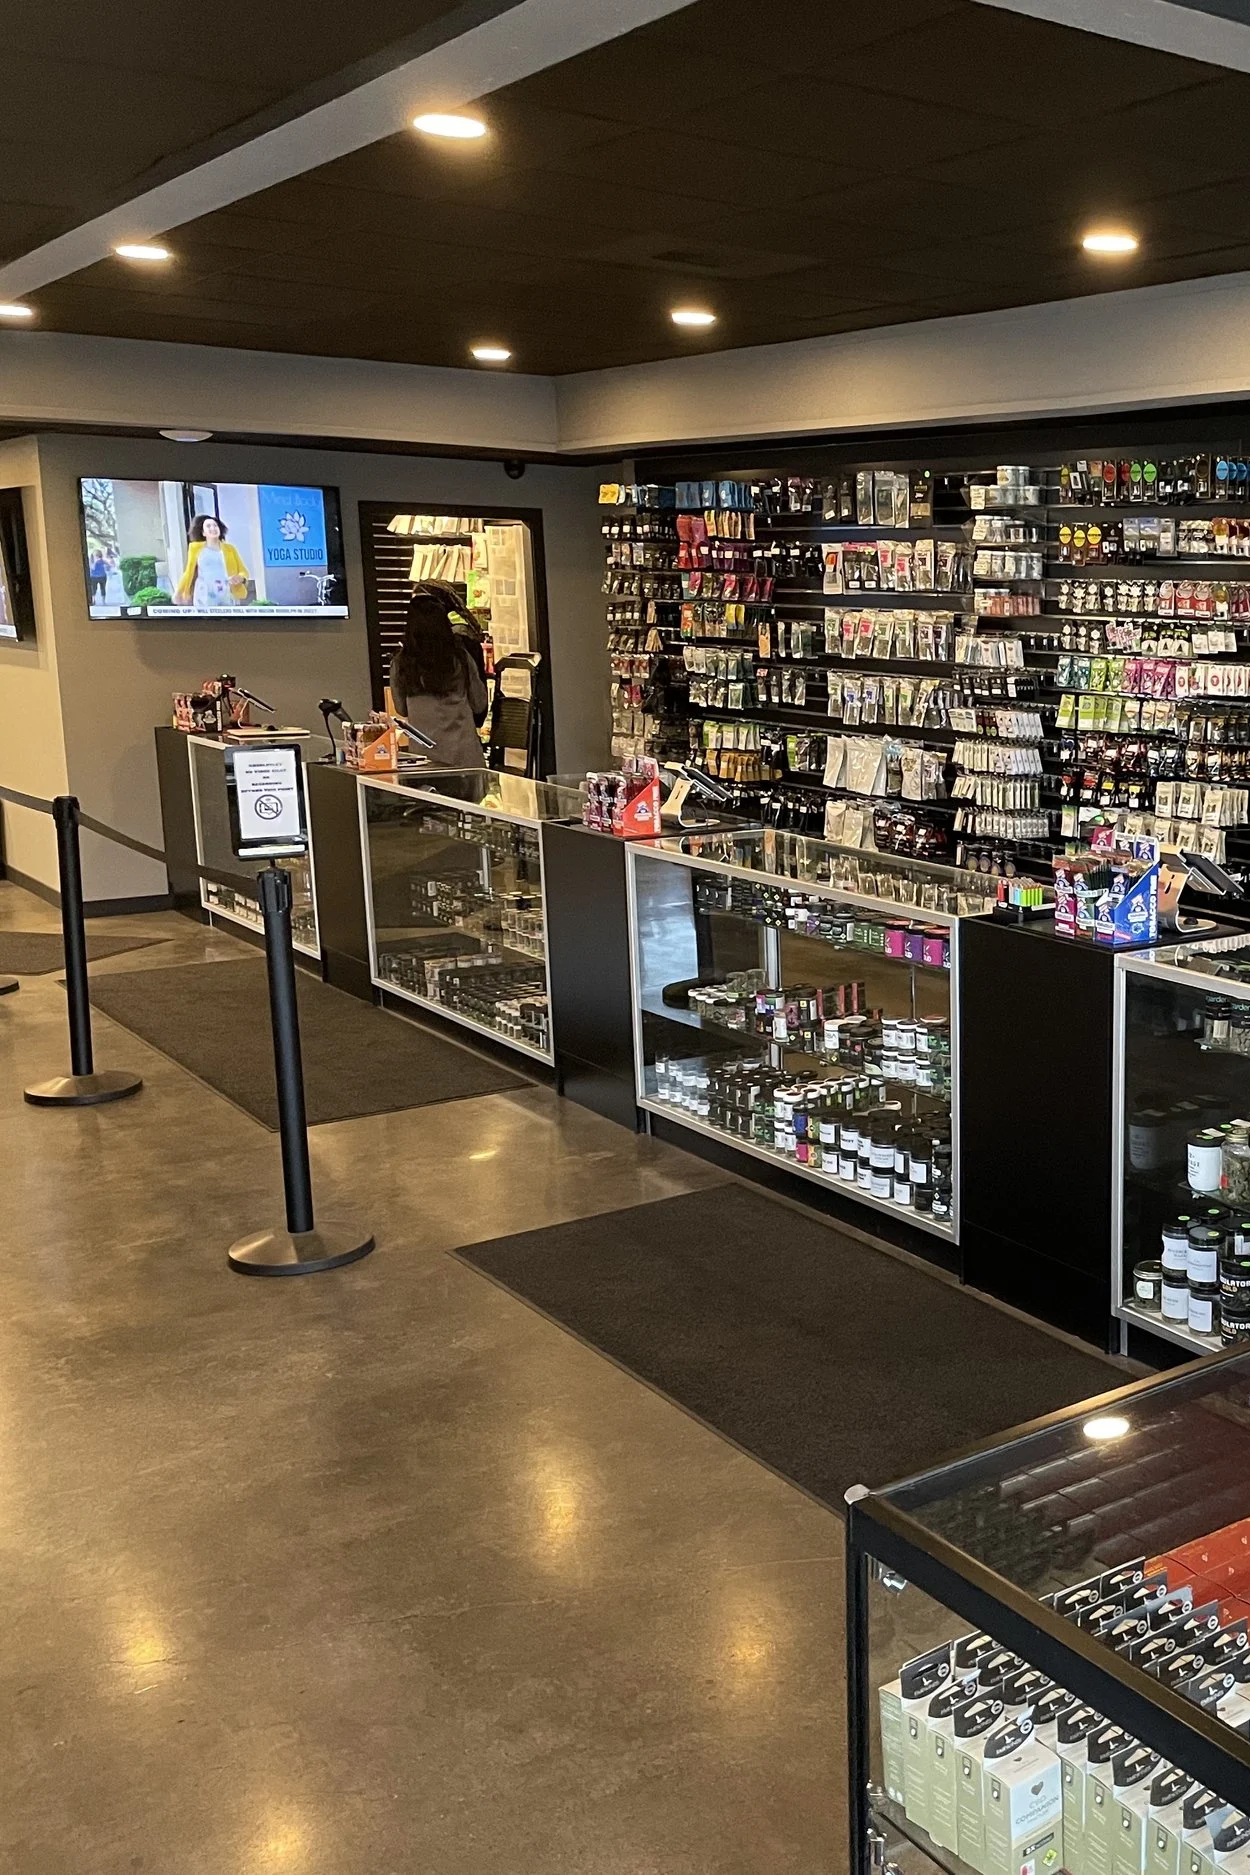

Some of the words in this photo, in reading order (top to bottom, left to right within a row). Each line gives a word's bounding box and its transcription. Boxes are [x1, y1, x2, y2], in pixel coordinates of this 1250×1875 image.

[268, 548, 291, 561] YOGA
[294, 548, 323, 560] STUDIO
[1016, 1795, 1060, 1825] COMPANION
